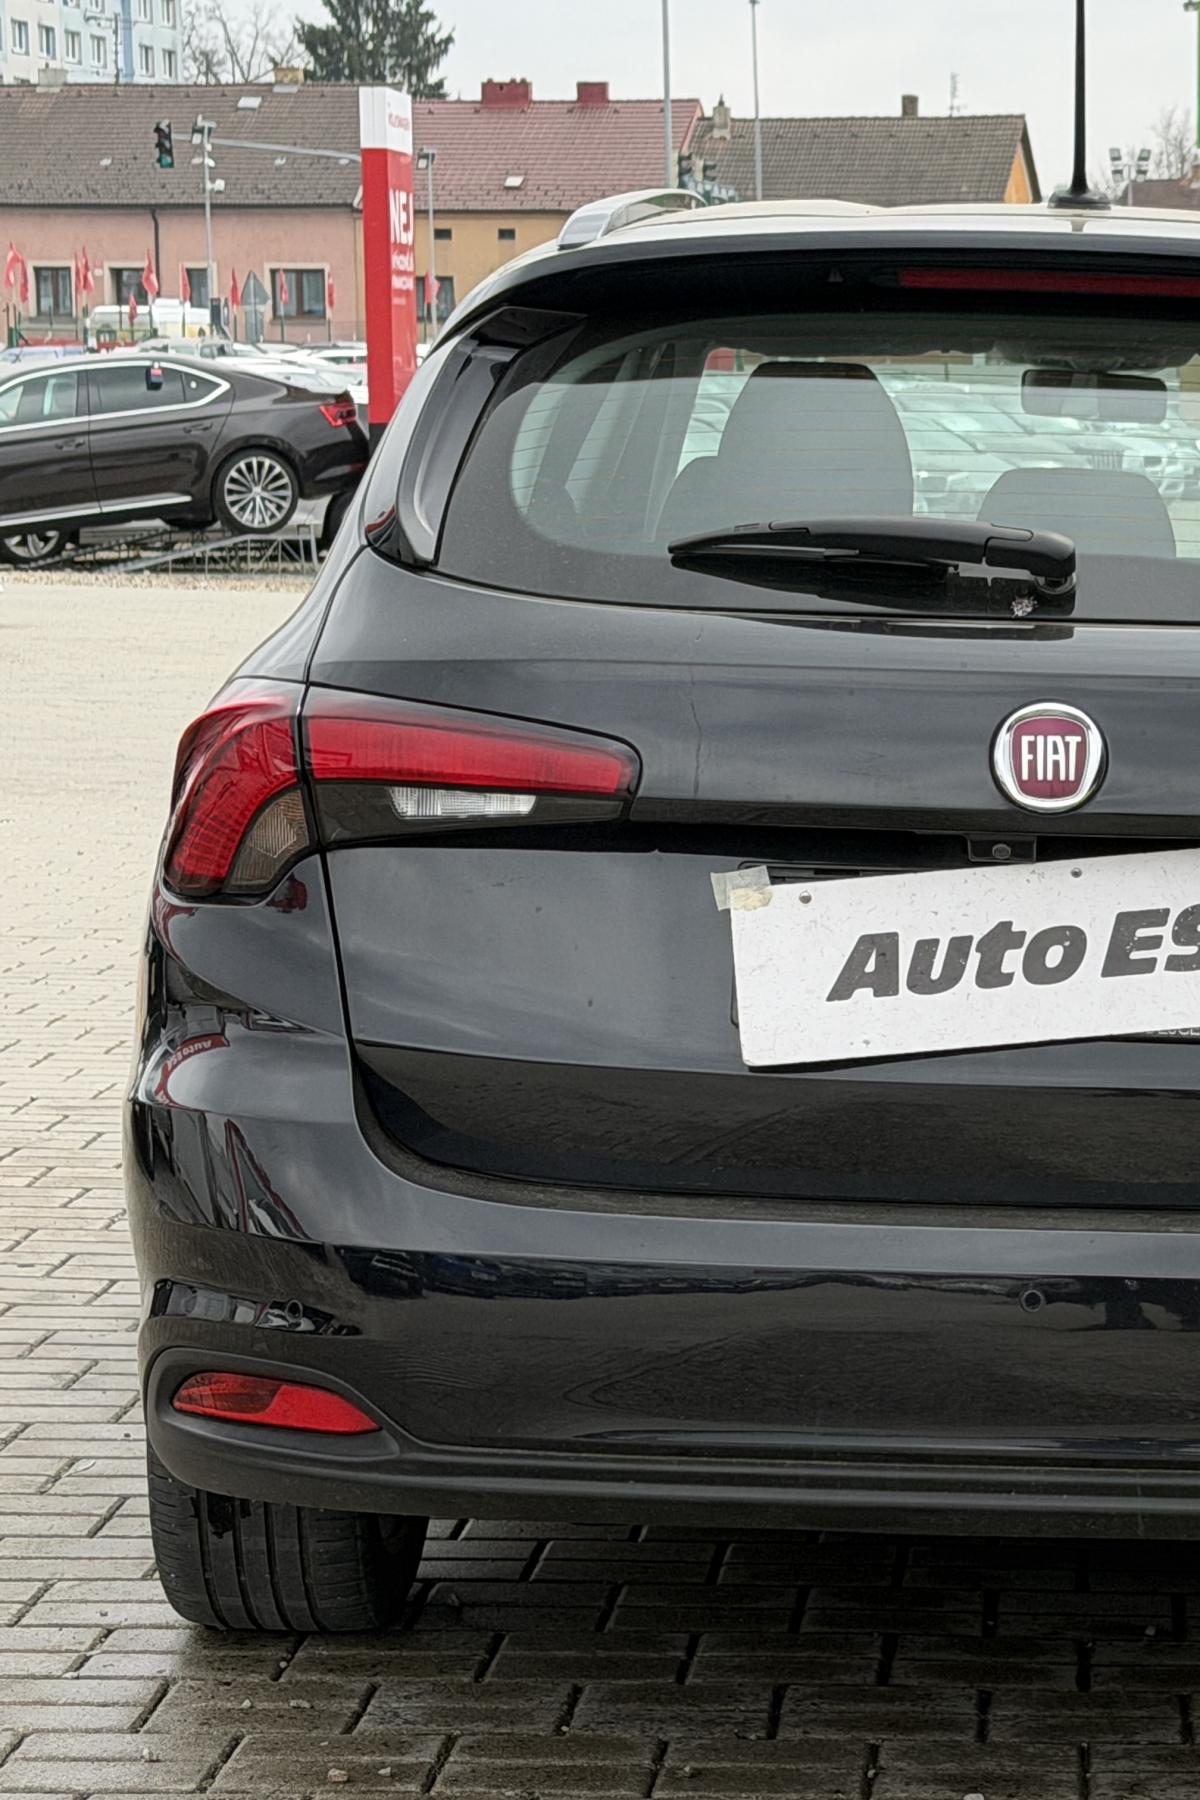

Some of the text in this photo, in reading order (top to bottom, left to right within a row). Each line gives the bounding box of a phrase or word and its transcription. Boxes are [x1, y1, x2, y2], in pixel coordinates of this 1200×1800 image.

[389, 188, 413, 246] NEJ
[1021, 735, 1082, 782] FIAT
[826, 920, 1087, 1002] Auto
